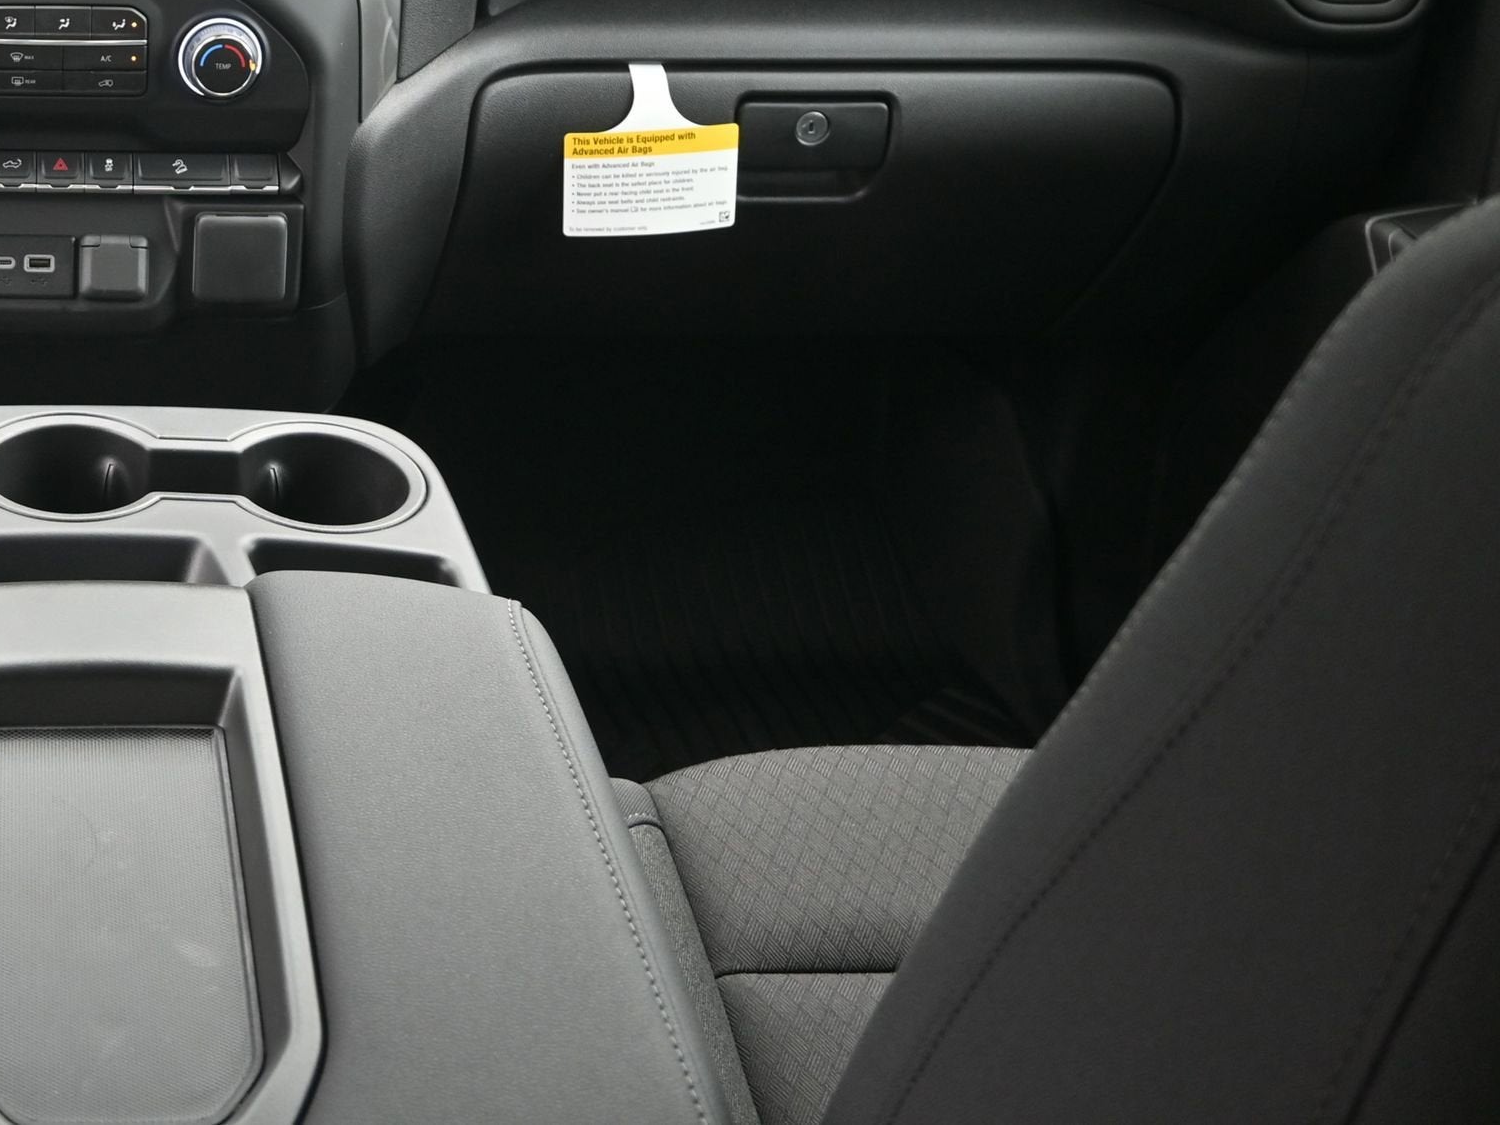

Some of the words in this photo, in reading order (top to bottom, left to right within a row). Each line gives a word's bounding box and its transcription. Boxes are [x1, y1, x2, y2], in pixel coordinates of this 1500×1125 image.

[100, 54, 112, 63] A/C
[215, 62, 232, 70] TEMP
[572, 137, 590, 146] This
[593, 135, 624, 145] Vehicle
[626, 135, 634, 144] is
[636, 133, 675, 144] Equipped
[677, 132, 696, 140] with
[572, 147, 615, 156] Advanced
[617, 146, 629, 154] Air
[631, 145, 653, 155] Bags
[602, 161, 630, 169] Advanced
[640, 160, 655, 169] Bags
